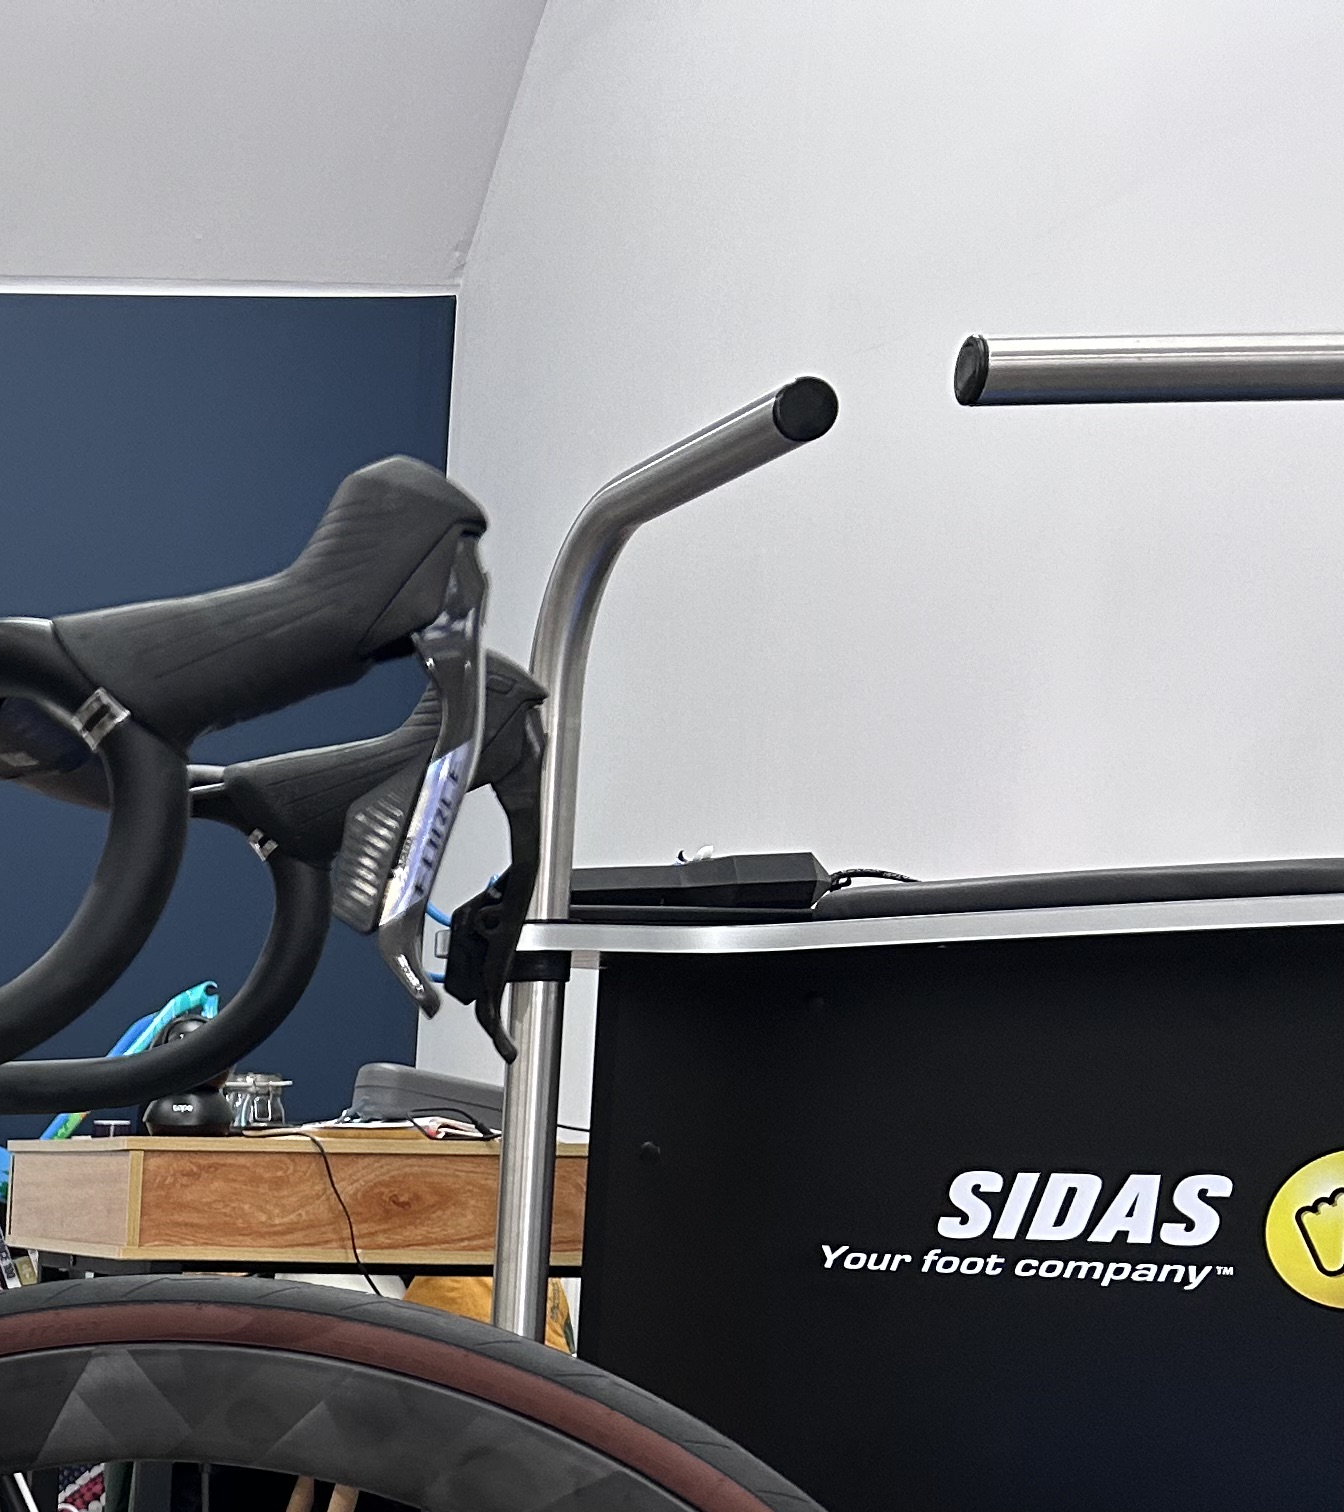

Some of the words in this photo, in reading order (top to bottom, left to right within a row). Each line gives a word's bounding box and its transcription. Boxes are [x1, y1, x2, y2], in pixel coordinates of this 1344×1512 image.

[936, 1170, 1234, 1247] SIDAS
[821, 1244, 912, 1273] Your
[921, 1248, 1005, 1276] foot
